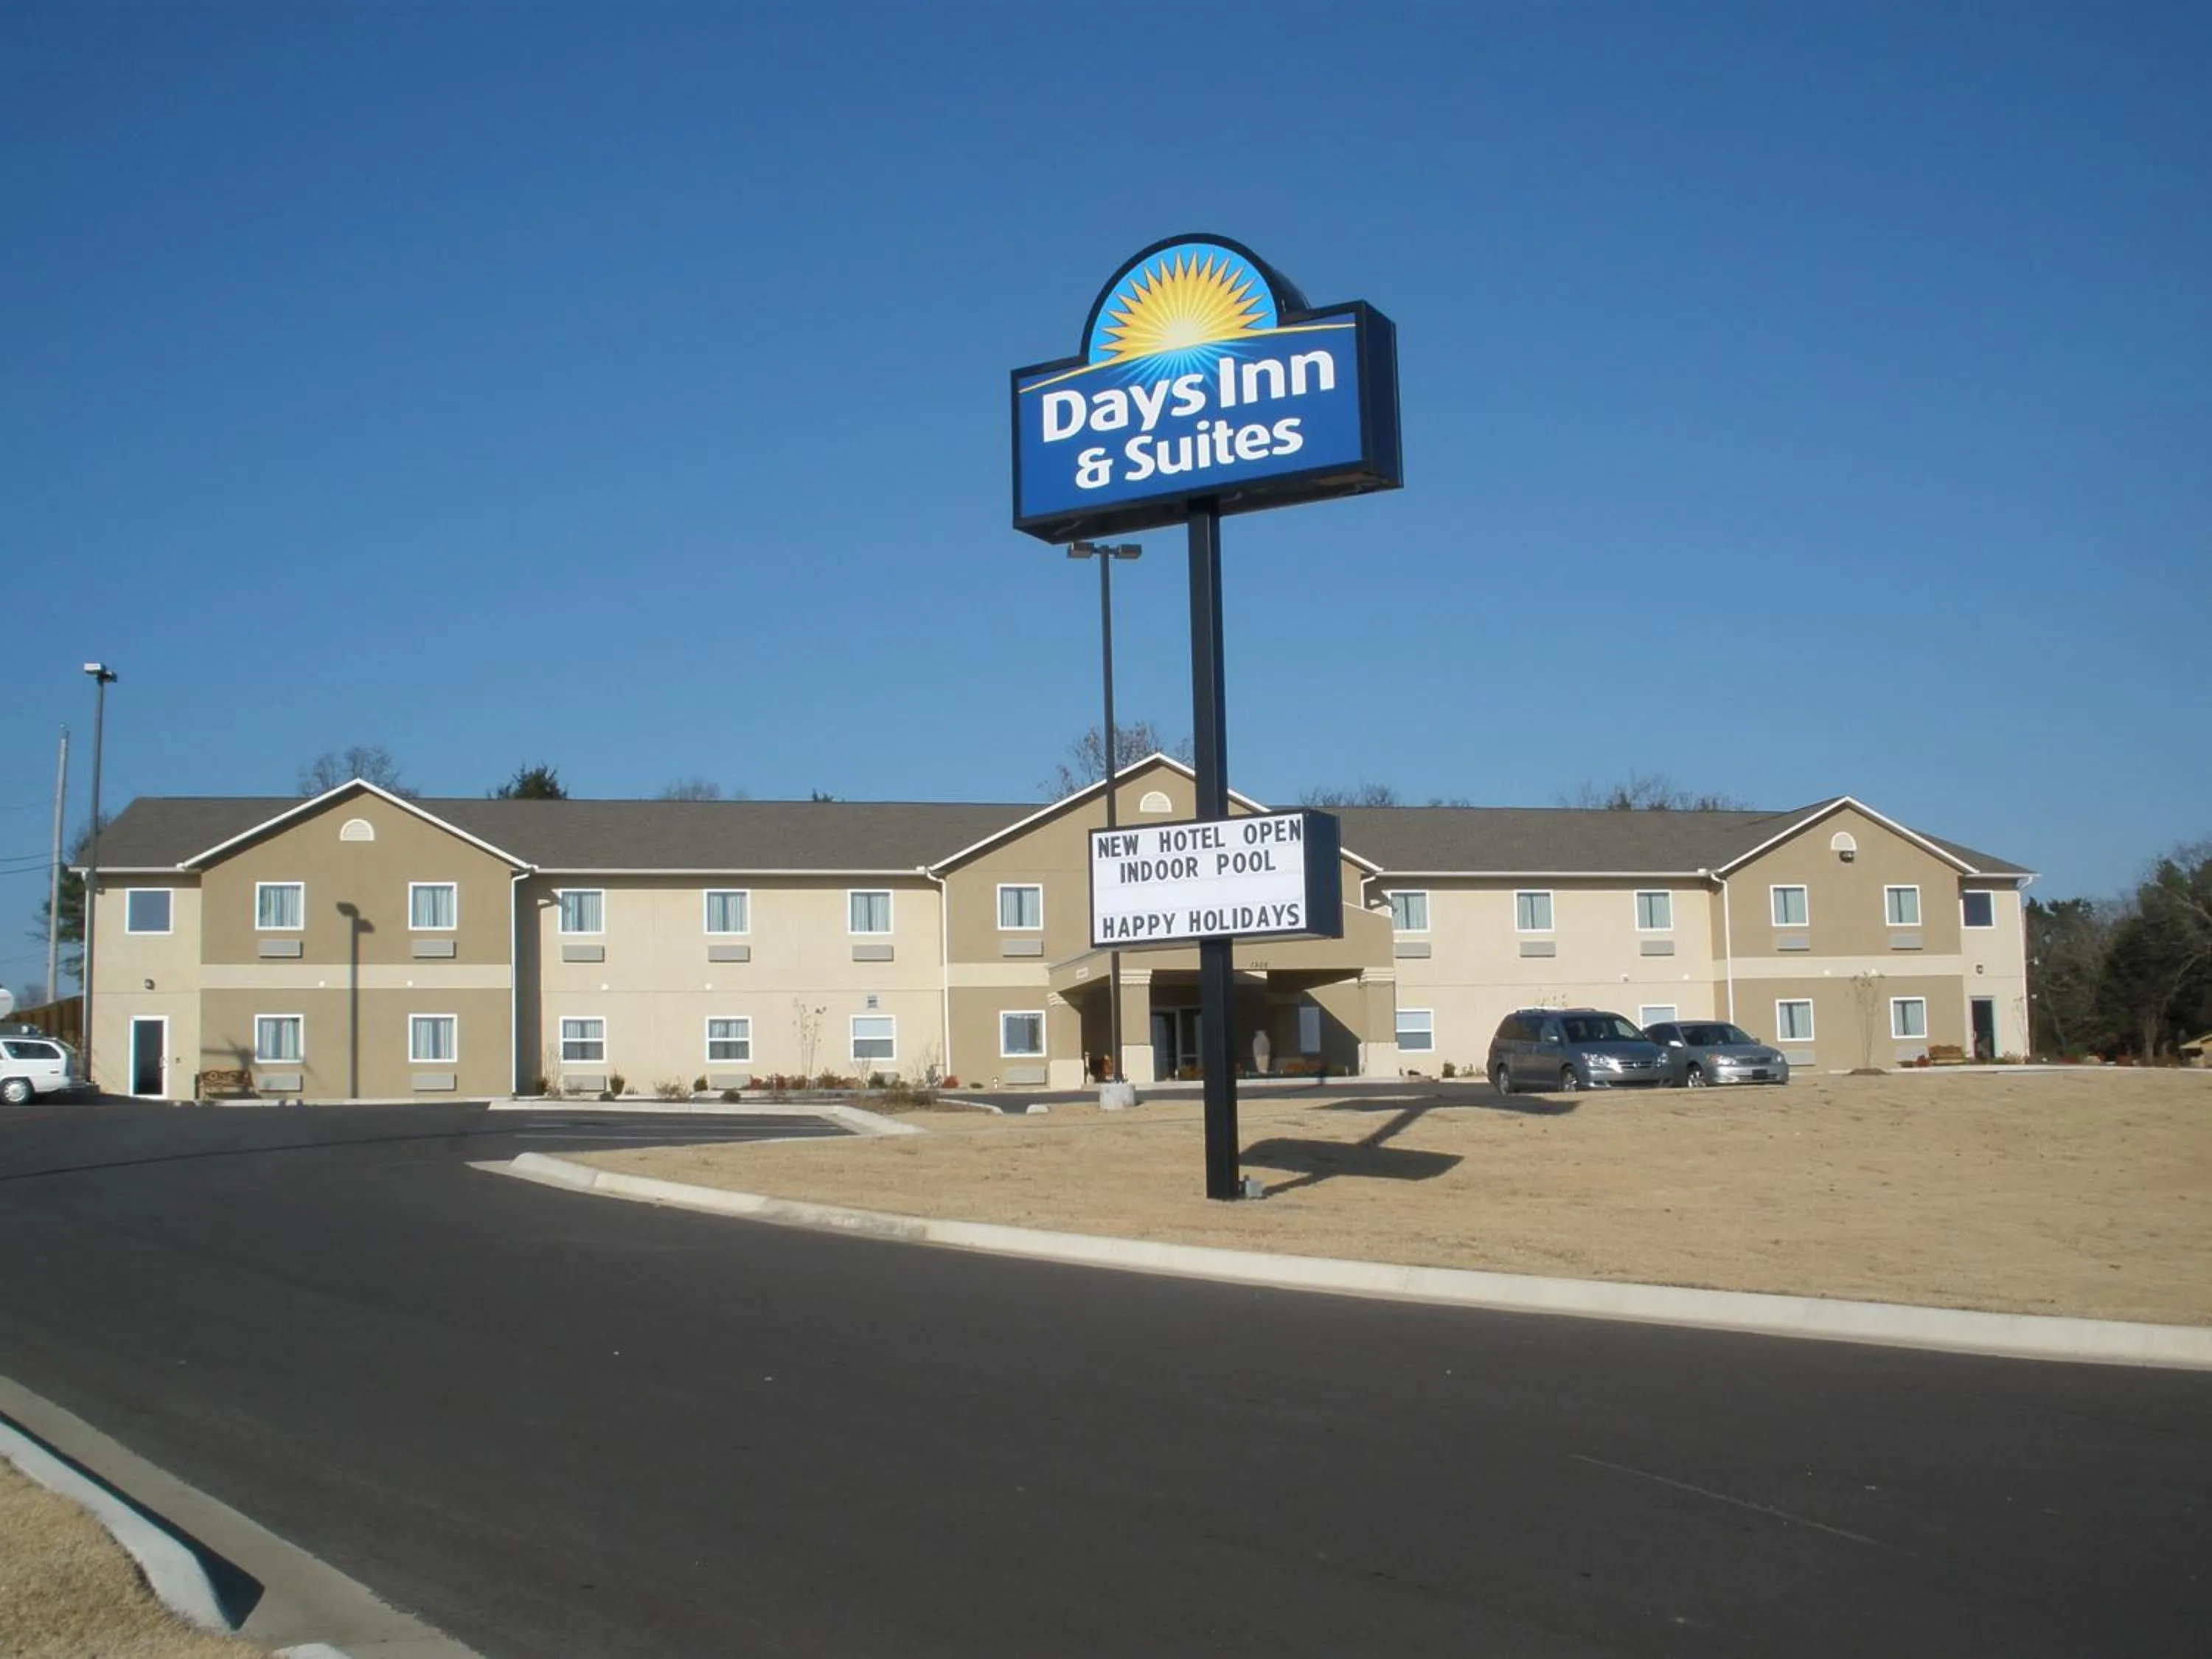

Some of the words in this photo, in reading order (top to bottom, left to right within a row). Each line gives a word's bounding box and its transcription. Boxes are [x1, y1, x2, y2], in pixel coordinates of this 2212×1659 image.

[1043, 373, 1206, 442] Days
[1219, 349, 1335, 408] Inn
[1075, 447, 1114, 489] &
[1124, 417, 1304, 481] Suites
[1098, 834, 1139, 858] NEW
[1159, 826, 1225, 853] HOTEL
[1243, 818, 1302, 845] OPEN
[1120, 857, 1198, 883] INDOOR
[1217, 849, 1276, 875] POOL
[1102, 913, 1175, 939] HAPPY
[1189, 903, 1299, 933] HOLIDAYS
